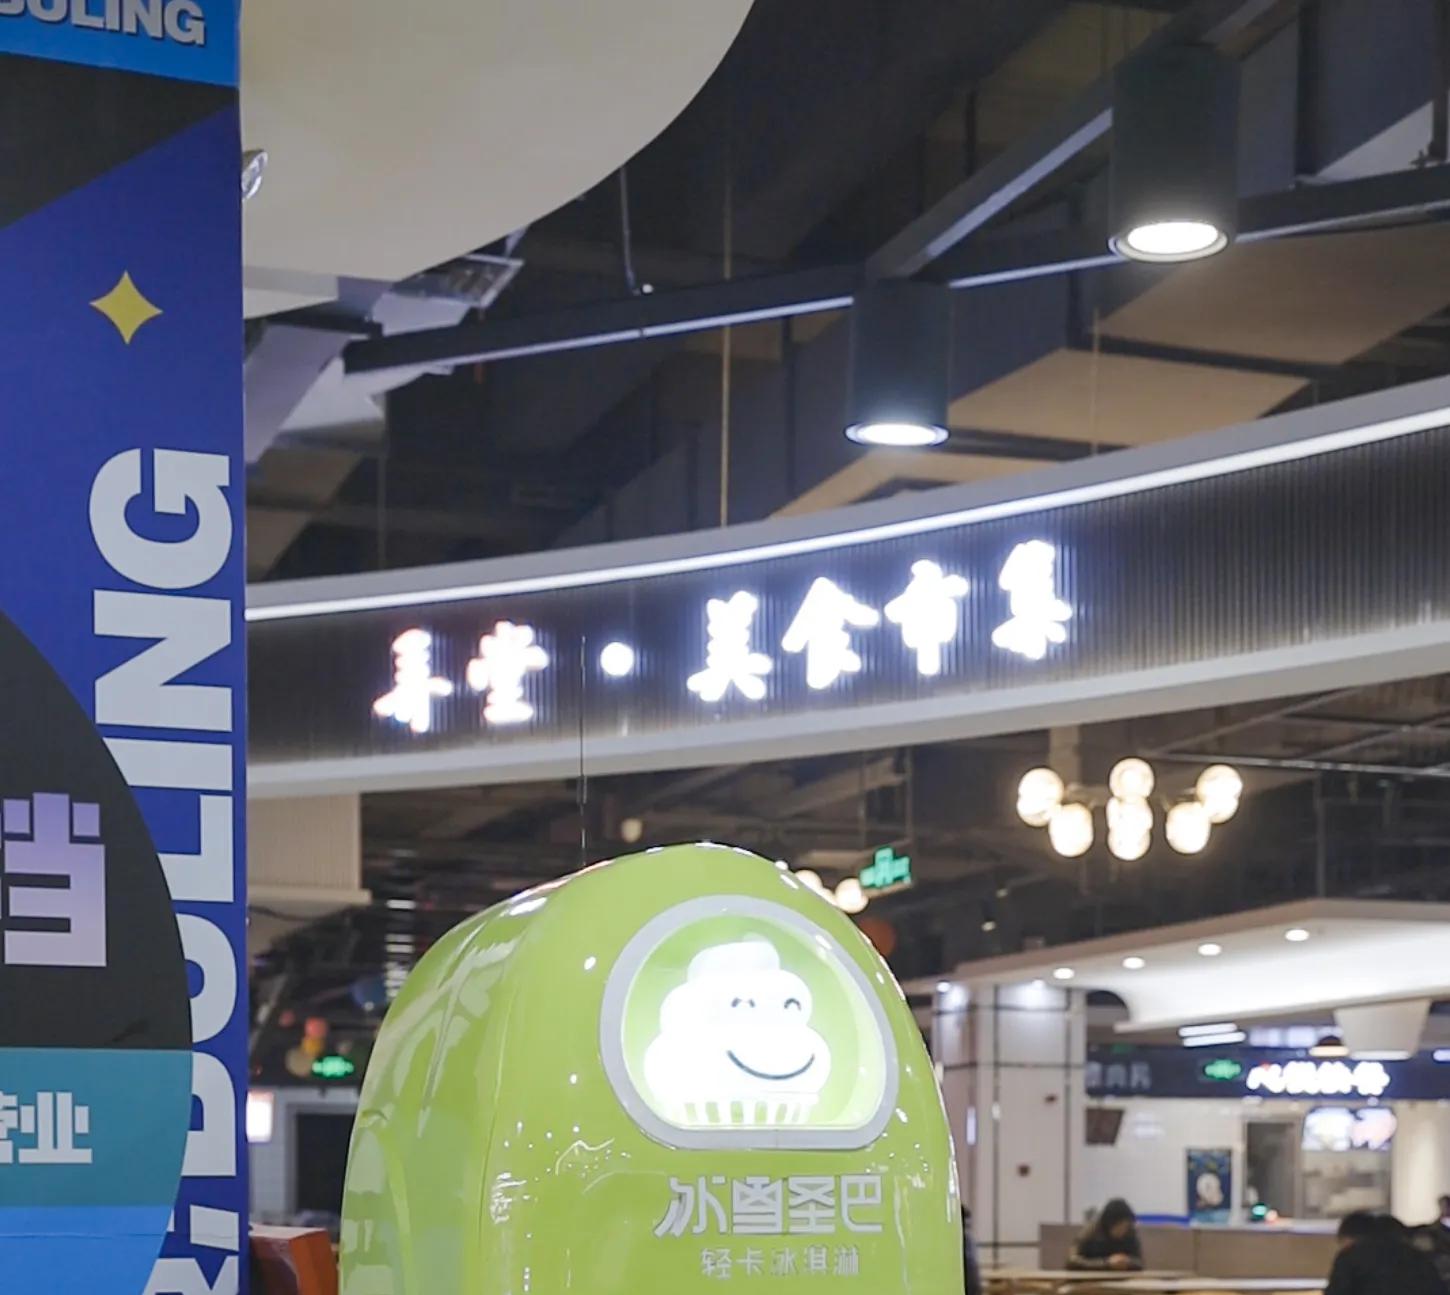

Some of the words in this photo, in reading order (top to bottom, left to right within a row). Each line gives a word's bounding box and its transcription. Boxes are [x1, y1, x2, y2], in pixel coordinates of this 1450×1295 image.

[0, 1089, 93, 1164] 业
[653, 1174, 884, 1238] 冰雪圣巴
[701, 1246, 861, 1279] 轻卡冰淇淋
